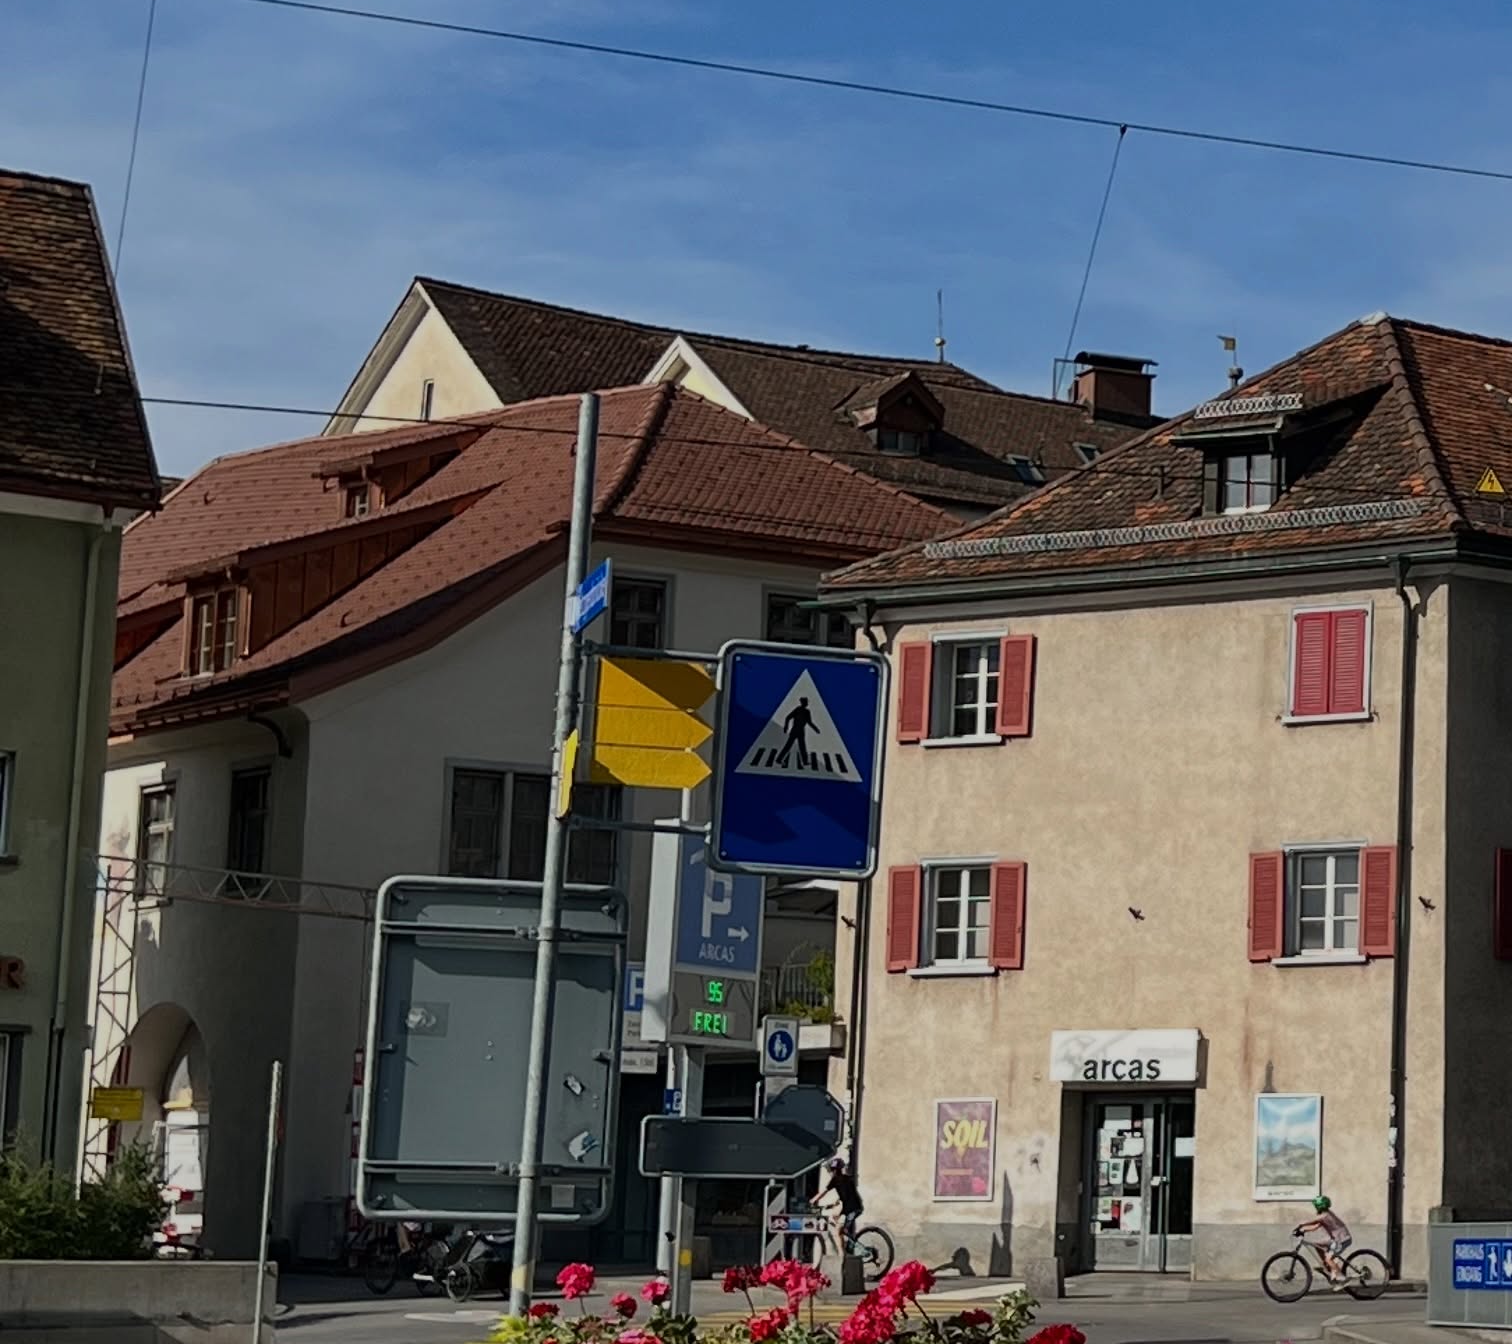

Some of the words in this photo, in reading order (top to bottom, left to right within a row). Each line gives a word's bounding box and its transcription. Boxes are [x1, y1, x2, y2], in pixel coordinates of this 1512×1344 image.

[701, 867, 733, 938] P
[699, 943, 735, 962] ARCAS
[693, 1011, 728, 1034] FREI
[1083, 1058, 1161, 1080] arcas
[941, 1119, 988, 1149] SOIL
